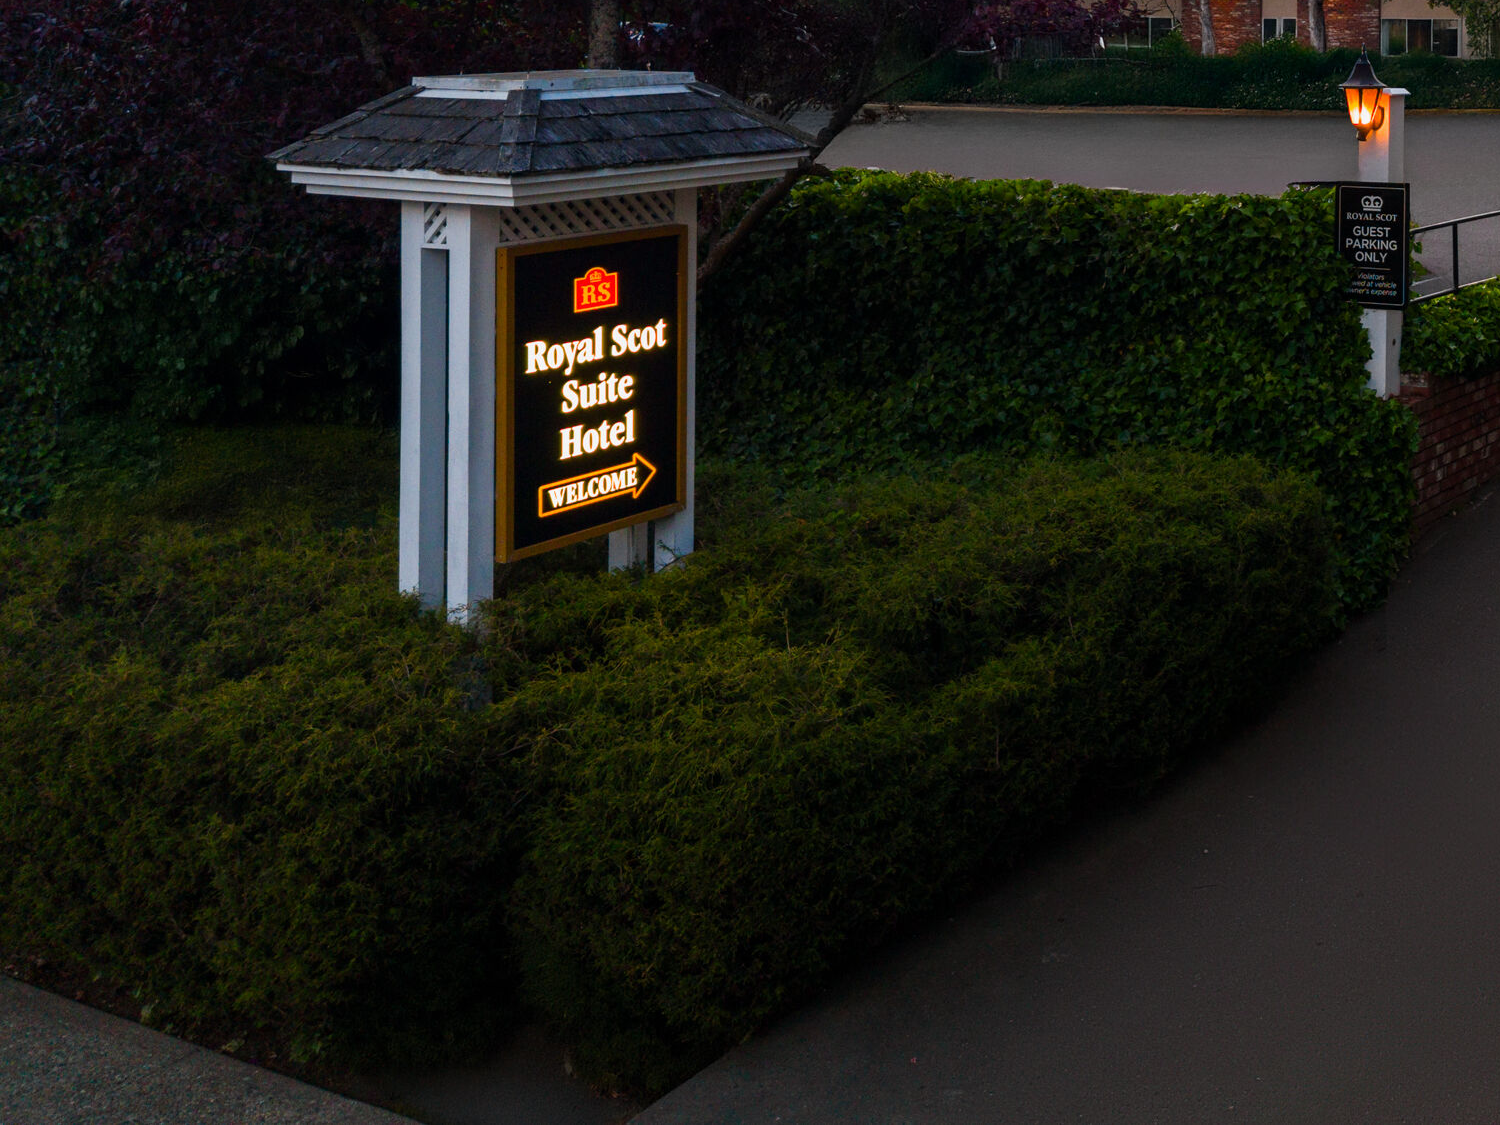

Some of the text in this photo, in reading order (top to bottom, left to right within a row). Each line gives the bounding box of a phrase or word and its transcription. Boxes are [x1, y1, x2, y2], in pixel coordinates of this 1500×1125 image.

[1346, 212, 1398, 222] ROYAL SCOT
[1353, 226, 1391, 238] GUEST
[1345, 238, 1398, 251] PARKING
[1355, 251, 1388, 263] ONLY
[581, 282, 611, 306] RS
[525, 318, 667, 375] Royal Scot
[561, 372, 634, 413] Suite
[559, 409, 635, 460] Hotel
[548, 466, 638, 508] WELCOME
